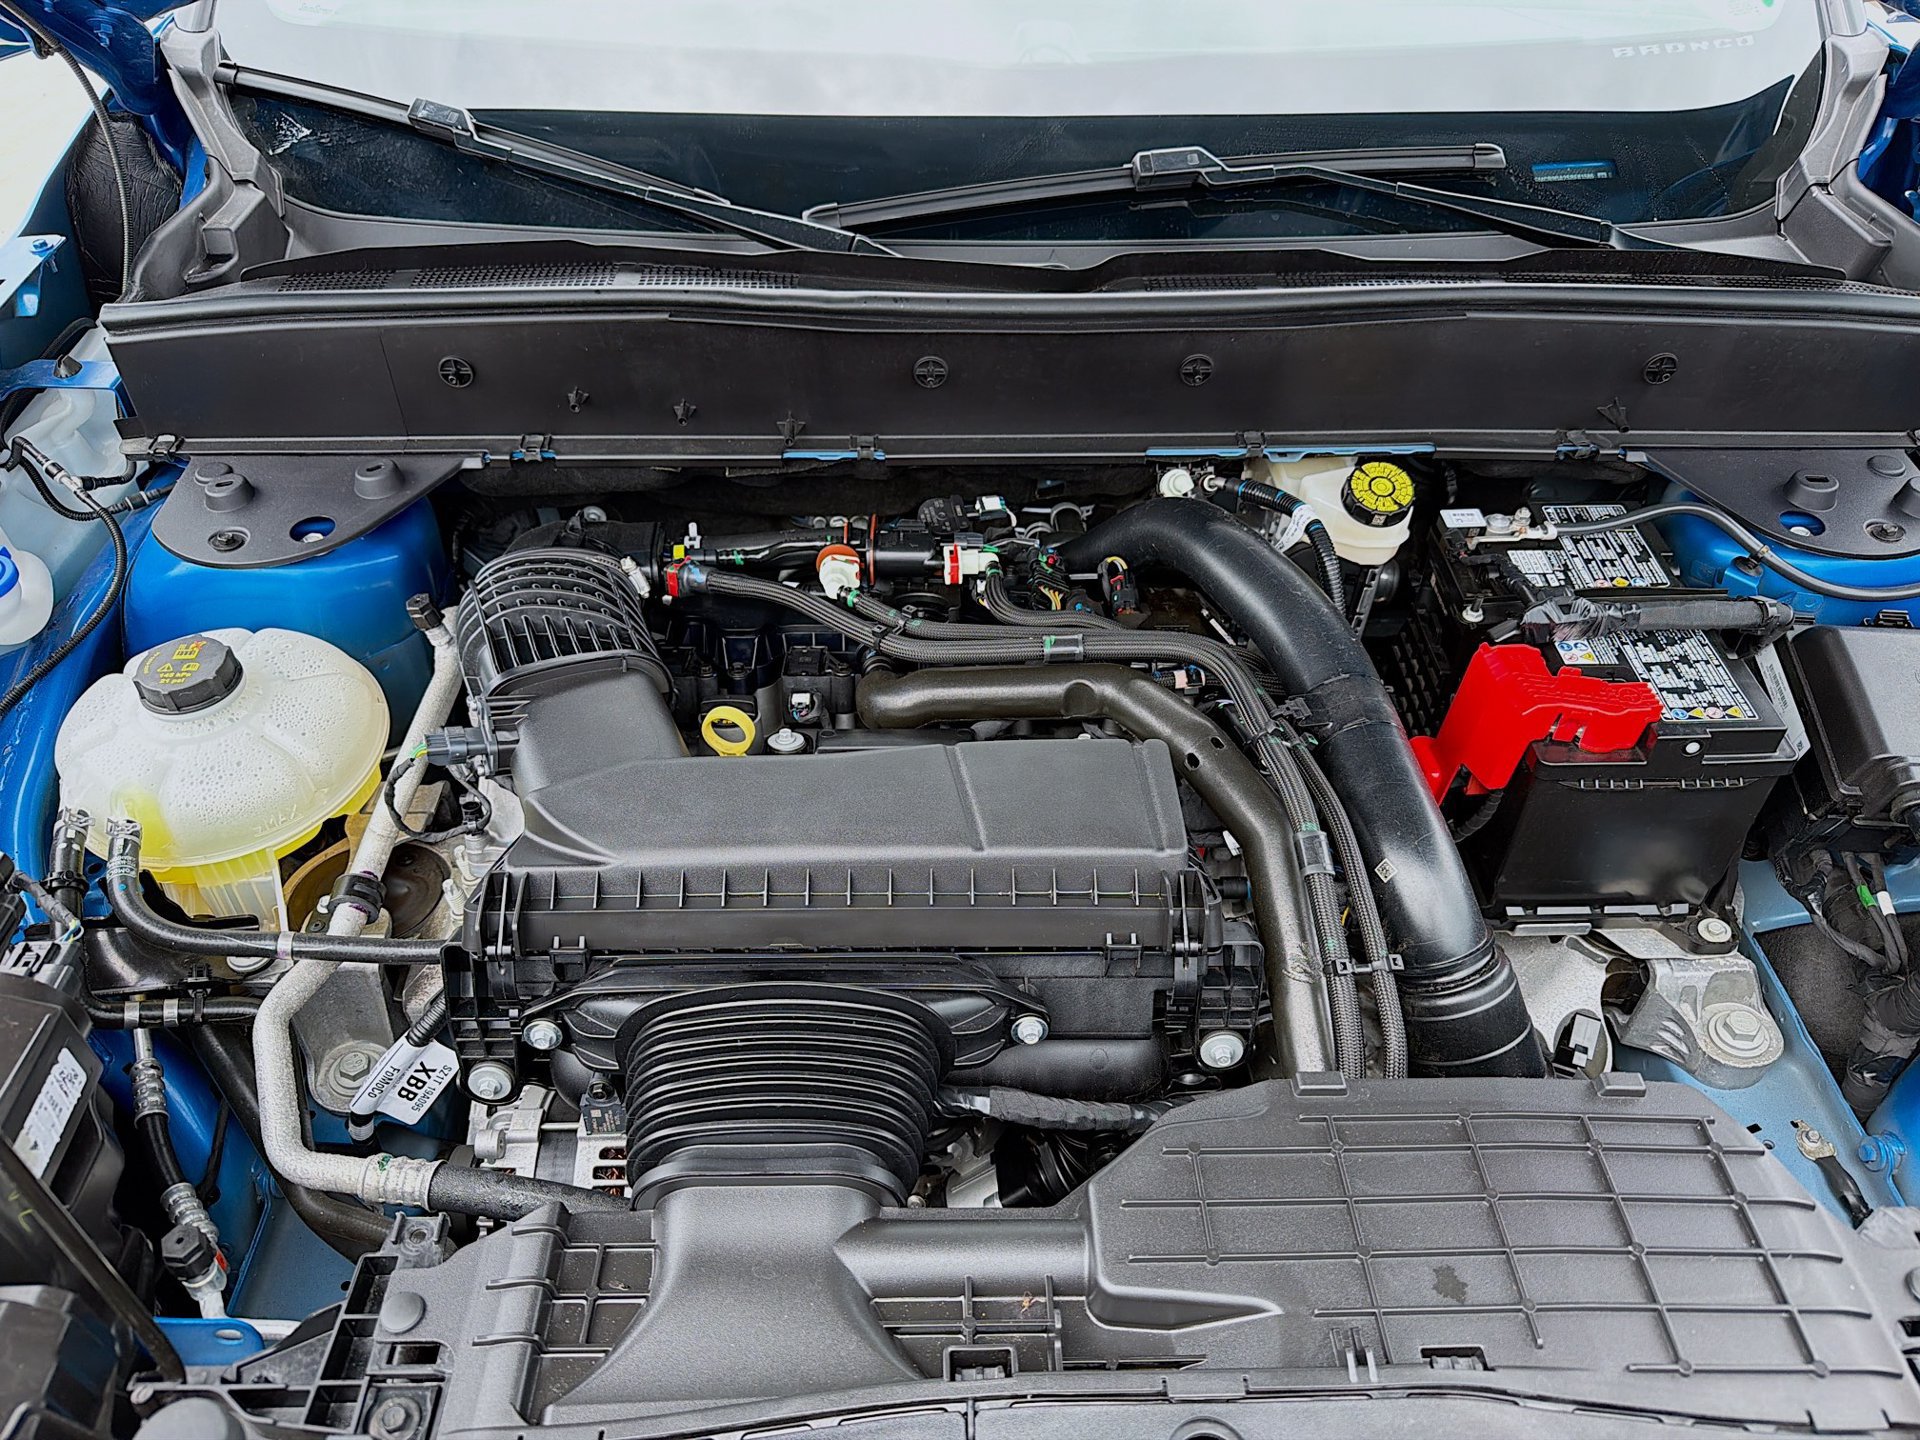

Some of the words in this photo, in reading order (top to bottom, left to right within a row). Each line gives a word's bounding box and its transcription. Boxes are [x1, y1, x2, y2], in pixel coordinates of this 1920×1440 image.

[1612, 34, 1755, 58] BRONCO
[367, 1065, 401, 1098] FoMoCo
[397, 1061, 437, 1101] XBB
[411, 1086, 436, 1112] 19A095
